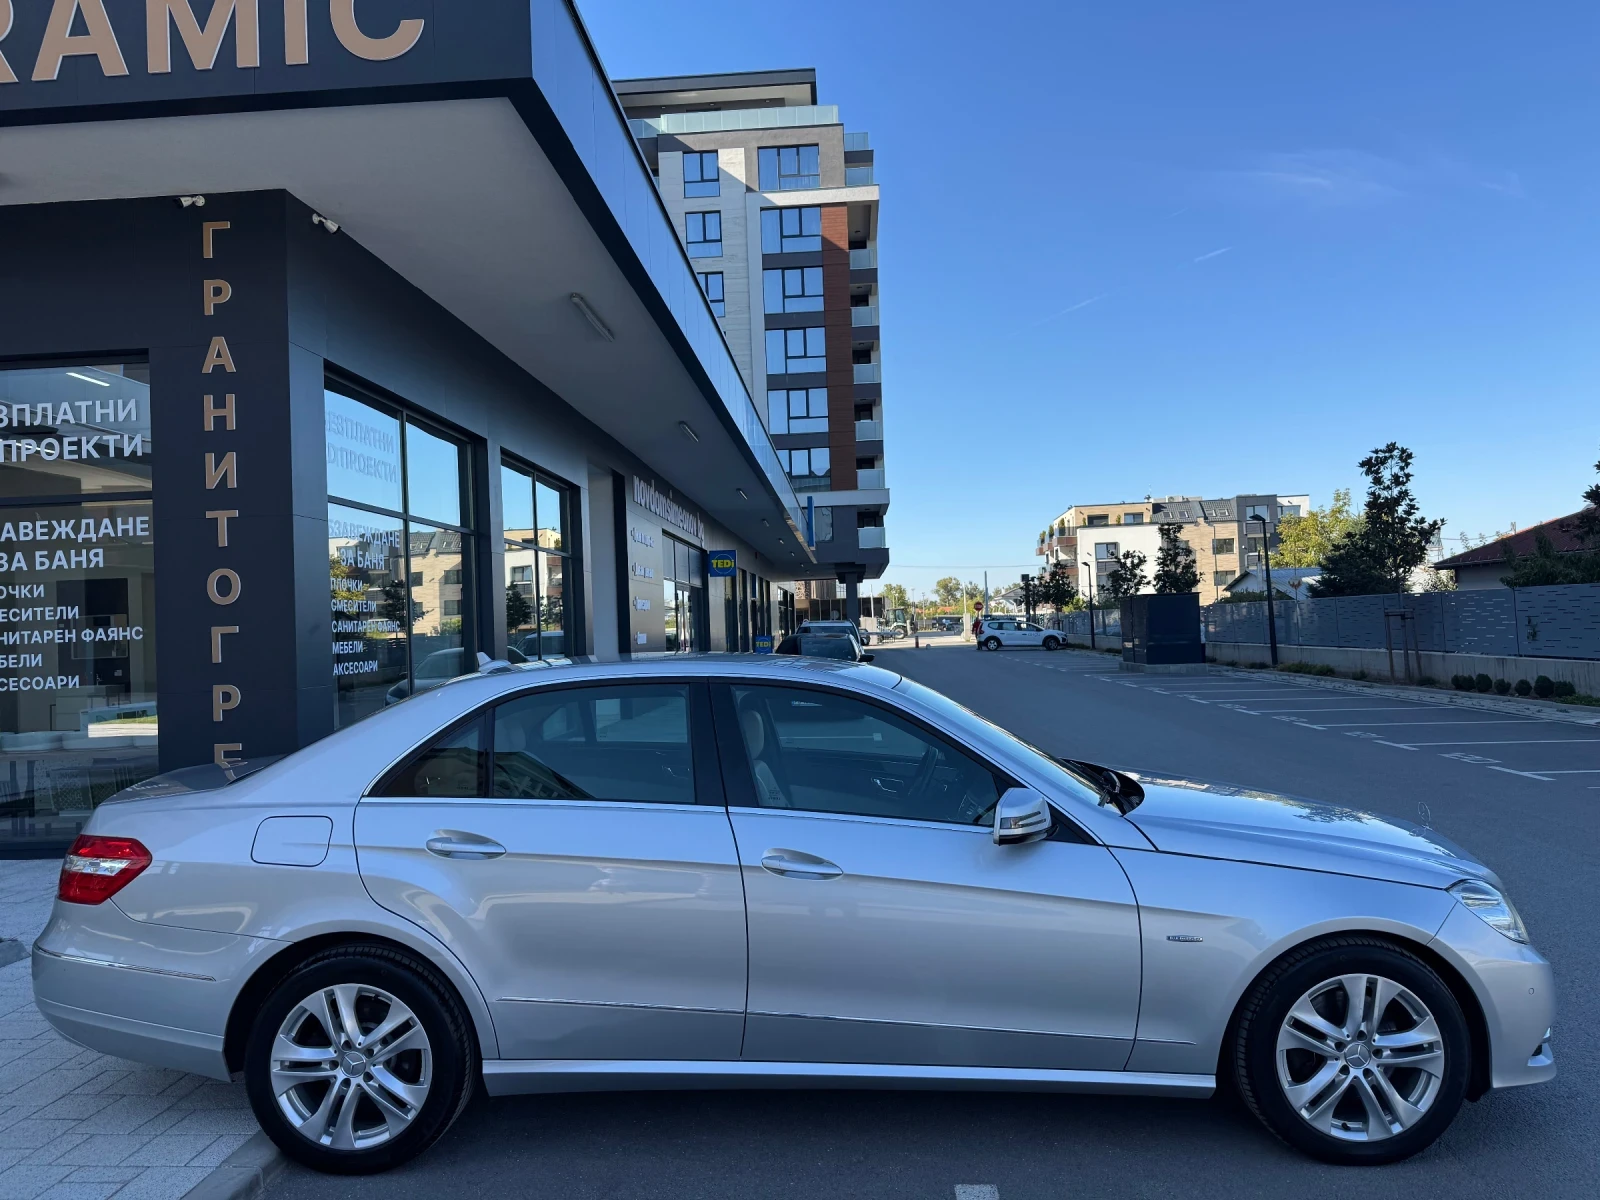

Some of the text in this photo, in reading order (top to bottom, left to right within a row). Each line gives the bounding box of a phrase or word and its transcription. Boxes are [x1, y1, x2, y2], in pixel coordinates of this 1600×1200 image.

[0, 516, 150, 543] АВЕЖДАНЕ
[35, 548, 104, 570] БАНЯ
[341, 547, 385, 571] ЗА БАНЯ
[711, 559, 735, 569] TEDi
[330, 577, 363, 592] ПЛОЧКИ
[0, 606, 79, 622] ЕСИТЕЛИ
[331, 599, 377, 613] СМЕСИТЕЛИ
[81, 626, 144, 643] ФАЯНС
[331, 620, 401, 633] САНИТАРЕН ФАЯНС
[332, 641, 364, 655] МЕБЕЛИ
[333, 660, 378, 677] АКСЕСОАРИ
